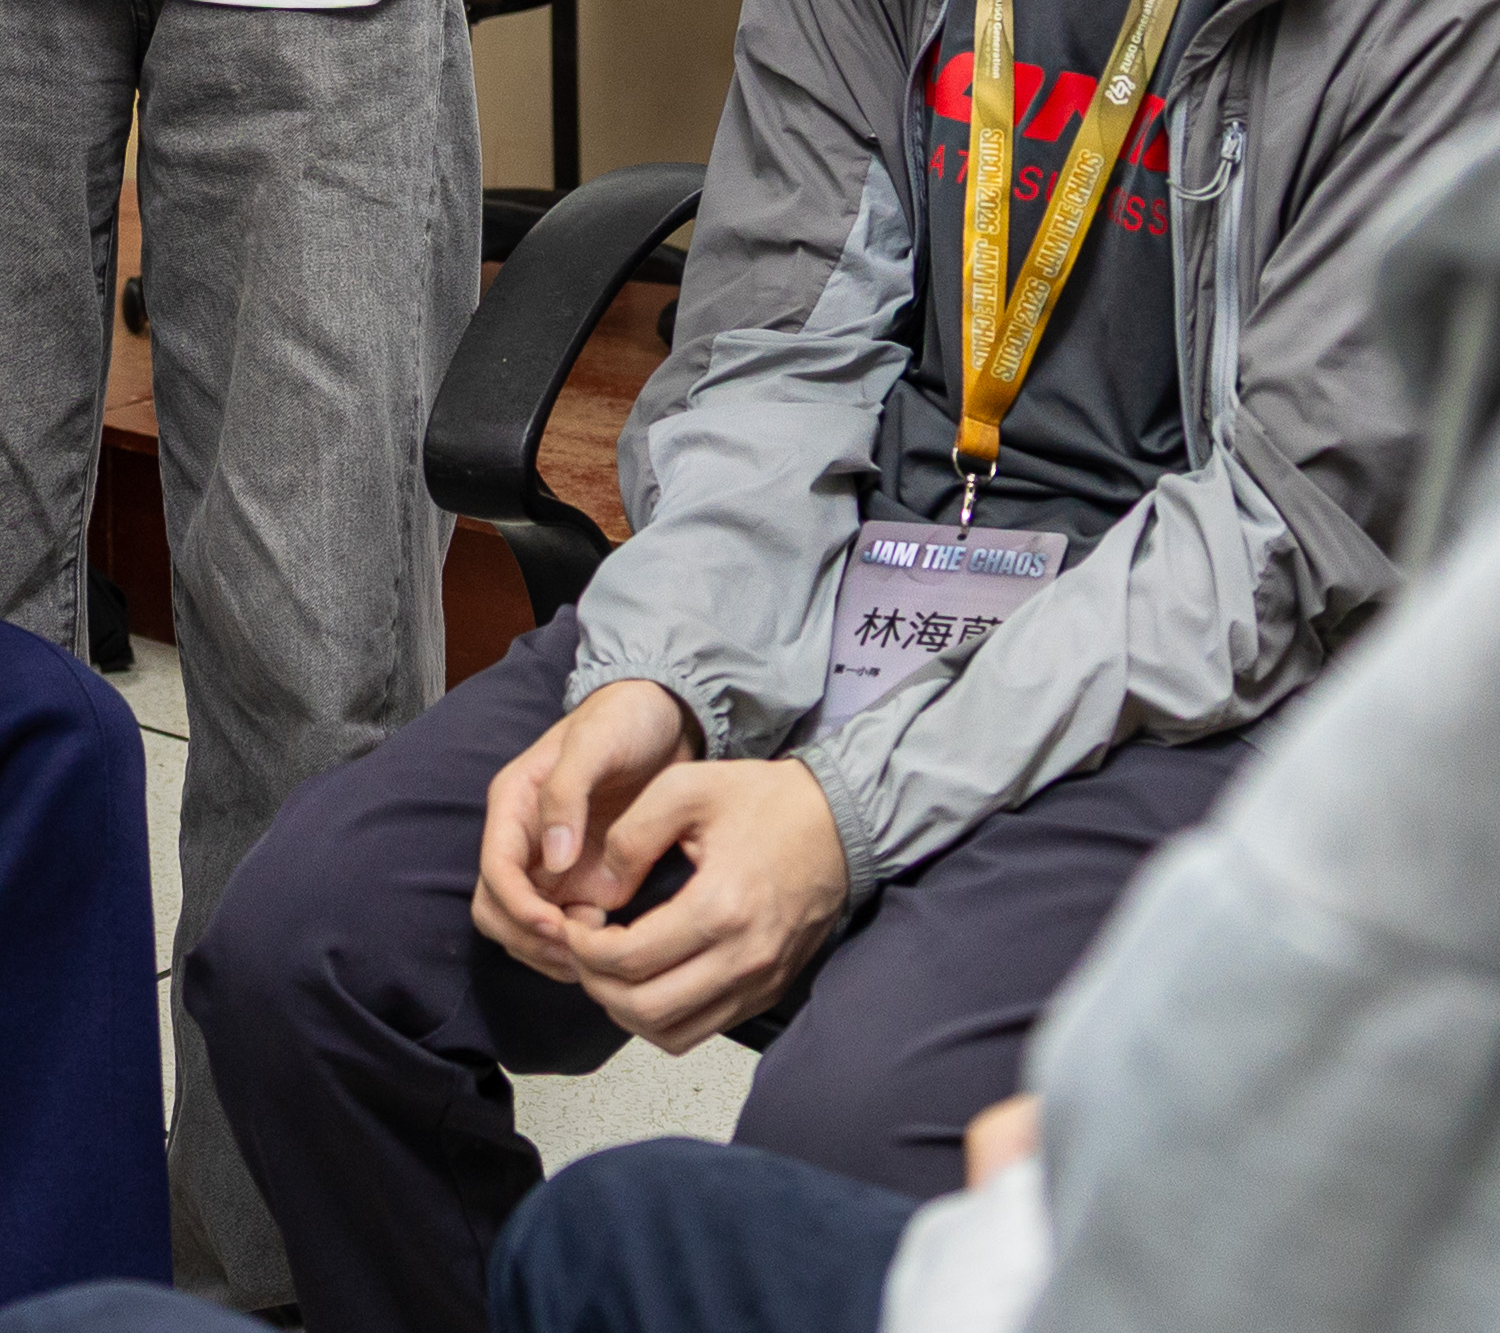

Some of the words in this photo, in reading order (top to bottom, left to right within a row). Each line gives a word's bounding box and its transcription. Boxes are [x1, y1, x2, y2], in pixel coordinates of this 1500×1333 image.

[991, 21, 1003, 80] Generation
[1119, 43, 1139, 74] ZUSO
[978, 127, 1005, 187] SITCON
[1062, 148, 1104, 208] CHAOS
[974, 184, 1002, 236] 2026
[1051, 201, 1084, 240] THE
[972, 238, 1000, 283] JAM
[1034, 230, 1071, 279] JAM
[972, 280, 999, 316] THE
[1014, 276, 1051, 328] 2026
[990, 321, 1033, 383] SITCON
[861, 539, 920, 569] JAM
[921, 543, 967, 572] THE
[967, 547, 1048, 578] CHAOS
